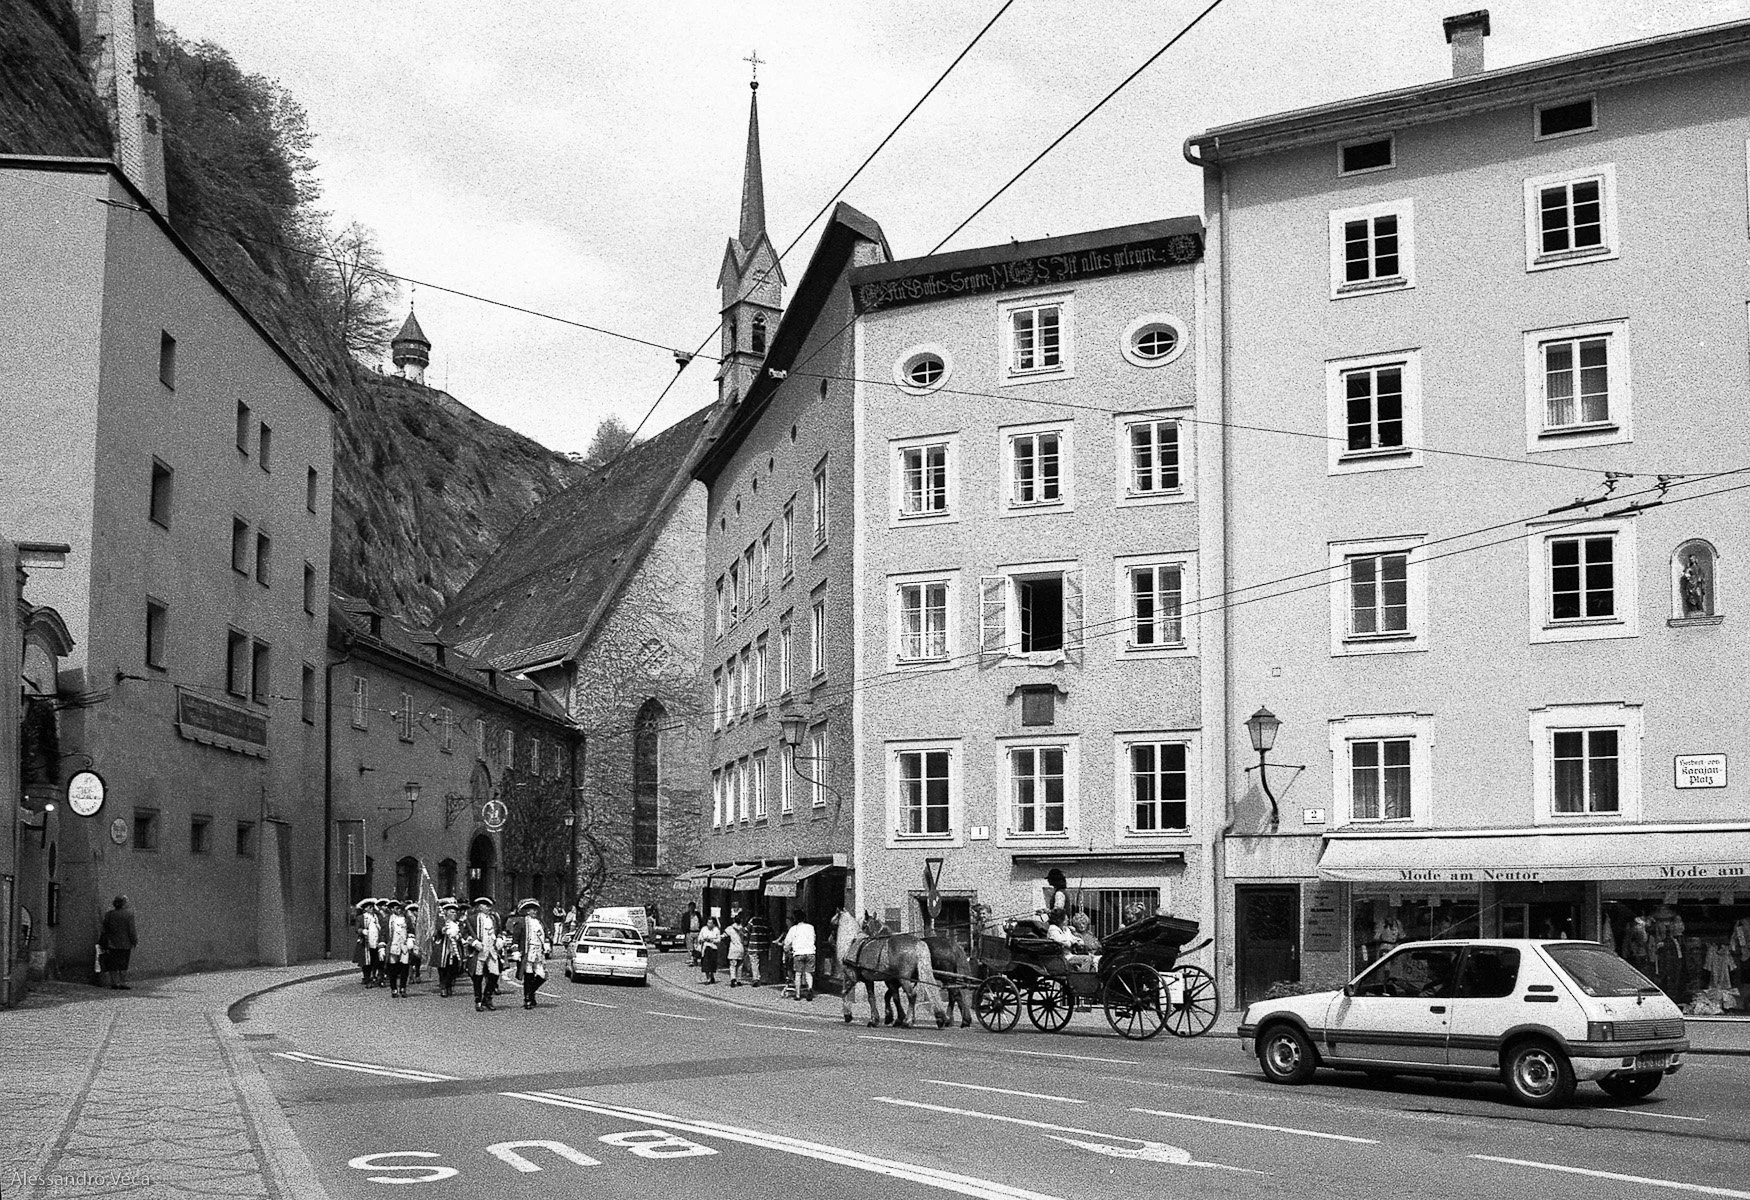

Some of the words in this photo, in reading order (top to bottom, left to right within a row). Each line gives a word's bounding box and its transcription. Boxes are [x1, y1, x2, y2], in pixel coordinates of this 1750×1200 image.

[1689, 775, 1714, 786] Platz
[1311, 810, 1318, 819] 2
[1399, 869, 1442, 882] Mode
[1450, 871, 1474, 881] am
[1483, 868, 1540, 882] Neutor
[1660, 865, 1708, 878] Mode
[1717, 867, 1744, 876] am
[347, 1130, 720, 1185] BUS
